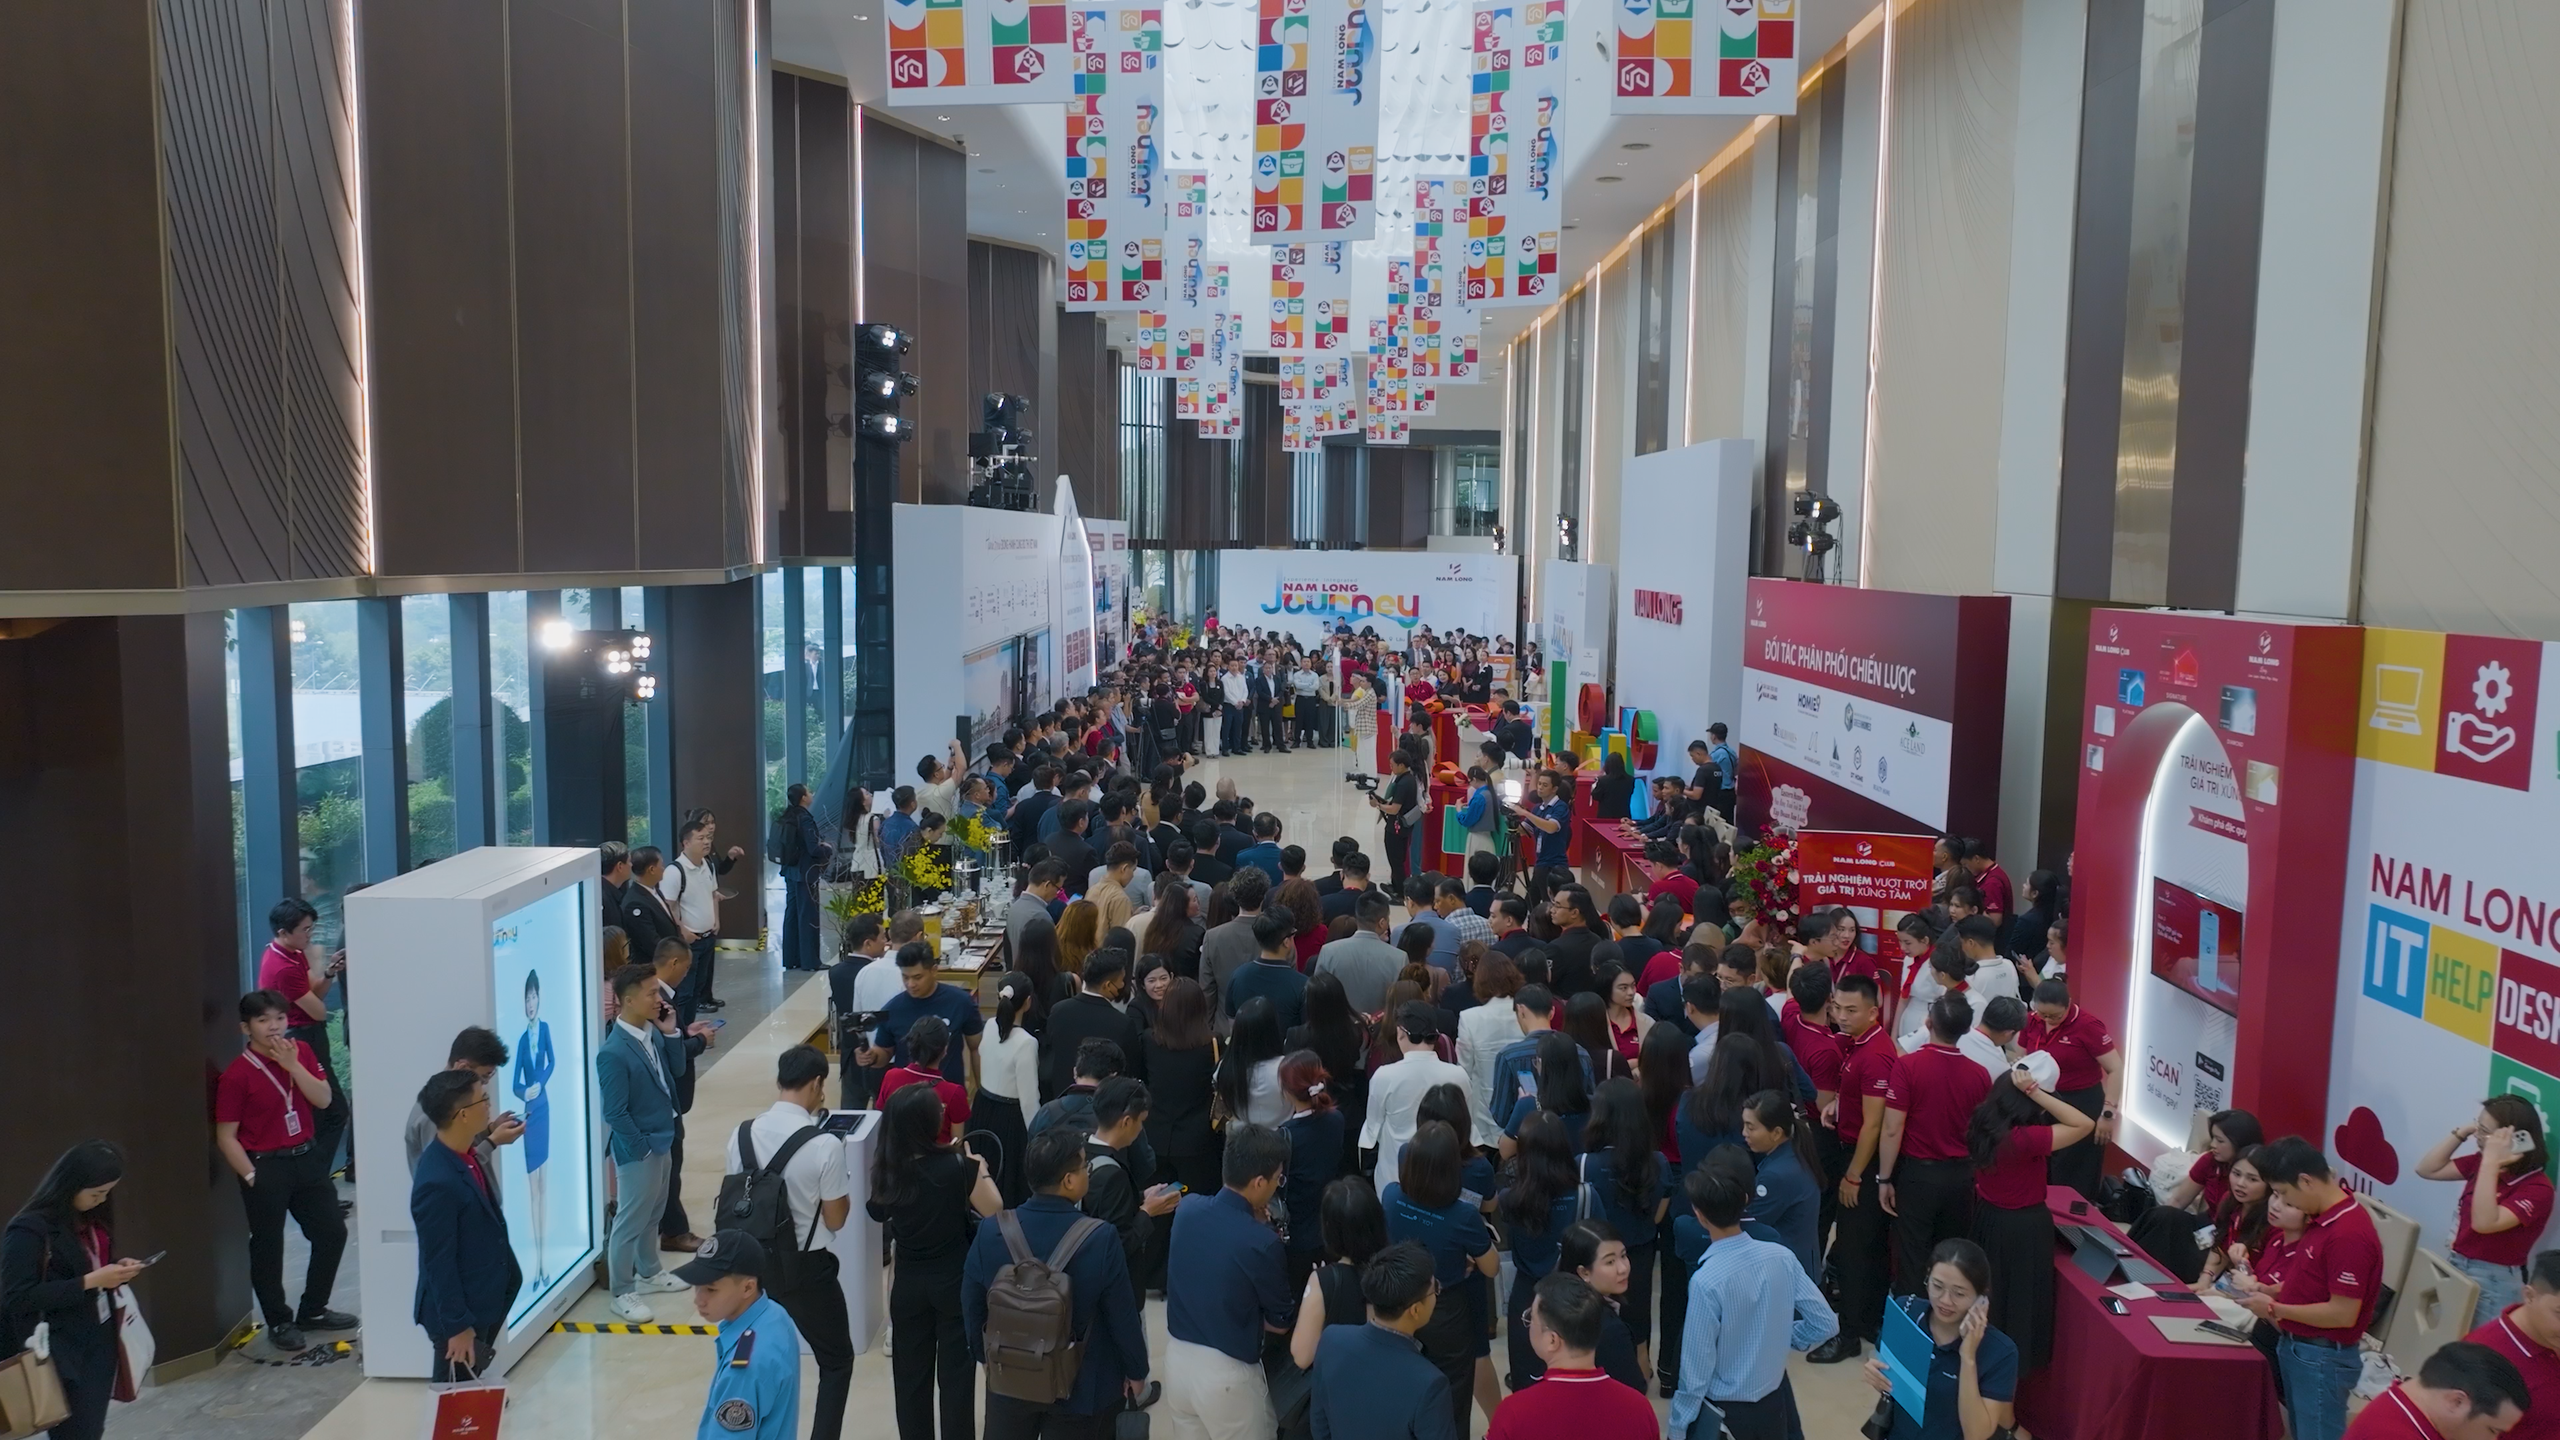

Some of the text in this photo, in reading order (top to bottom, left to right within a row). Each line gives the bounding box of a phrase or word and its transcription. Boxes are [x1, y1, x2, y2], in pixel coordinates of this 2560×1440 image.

[1337, 24, 1347, 89] NAM LONG
[1283, 583, 1359, 593] NAM LONG
[1261, 582, 1420, 629] Journey
[1652, 591, 1683, 625] LONG
[1765, 635, 1917, 698] ĐỐI TÁC PHÂN PHỐI CHIẾN LƯỢC
[2181, 754, 2233, 781] TRẢI NGHIỆM
[2190, 776, 2205, 791] GIÁ
[2207, 780, 2219, 798] TRỊ
[1833, 856, 1854, 864] NAM
[1855, 858, 1877, 866] LONG
[1803, 871, 1928, 890] TRẢI NGHIỆM VƯỢT TRỘI
[1817, 882, 1912, 901] GIÁ TRỊ XỨNG TẦM
[2371, 853, 2452, 916] NAM
[2372, 919, 2425, 998] IT
[2431, 953, 2494, 1013] HELP
[2150, 1055, 2179, 1087] SCAN
